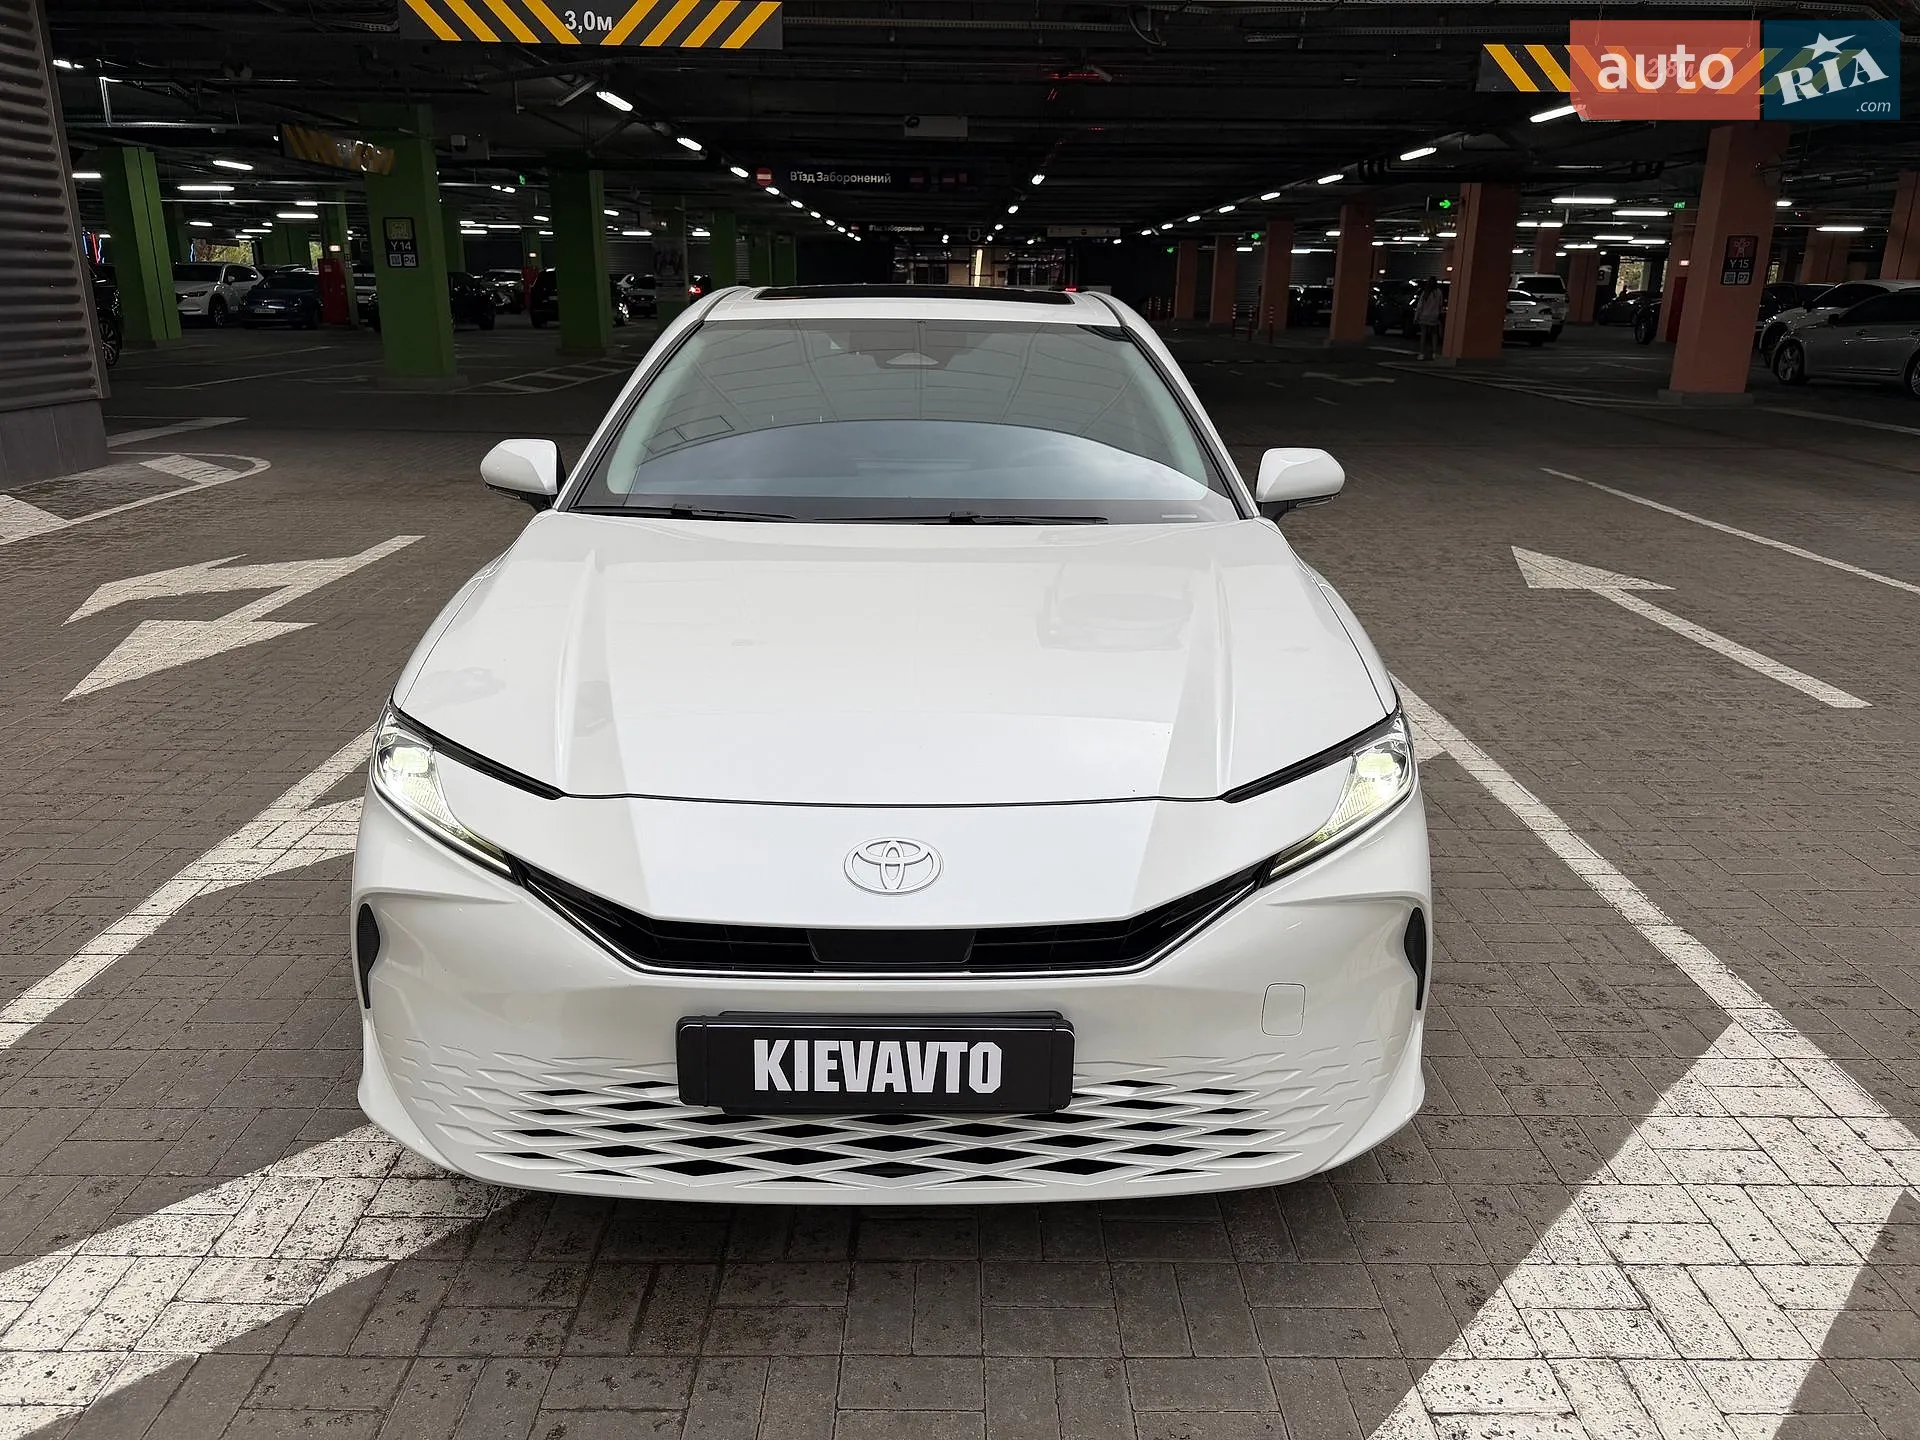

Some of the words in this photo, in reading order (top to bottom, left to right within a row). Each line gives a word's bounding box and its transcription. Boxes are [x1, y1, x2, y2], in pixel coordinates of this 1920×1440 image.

[816, 172, 891, 184] Заборонений
[400, 241, 411, 251] 14
[1739, 259, 1750, 268] 15
[753, 1039, 1003, 1094] KIEVAVTO
